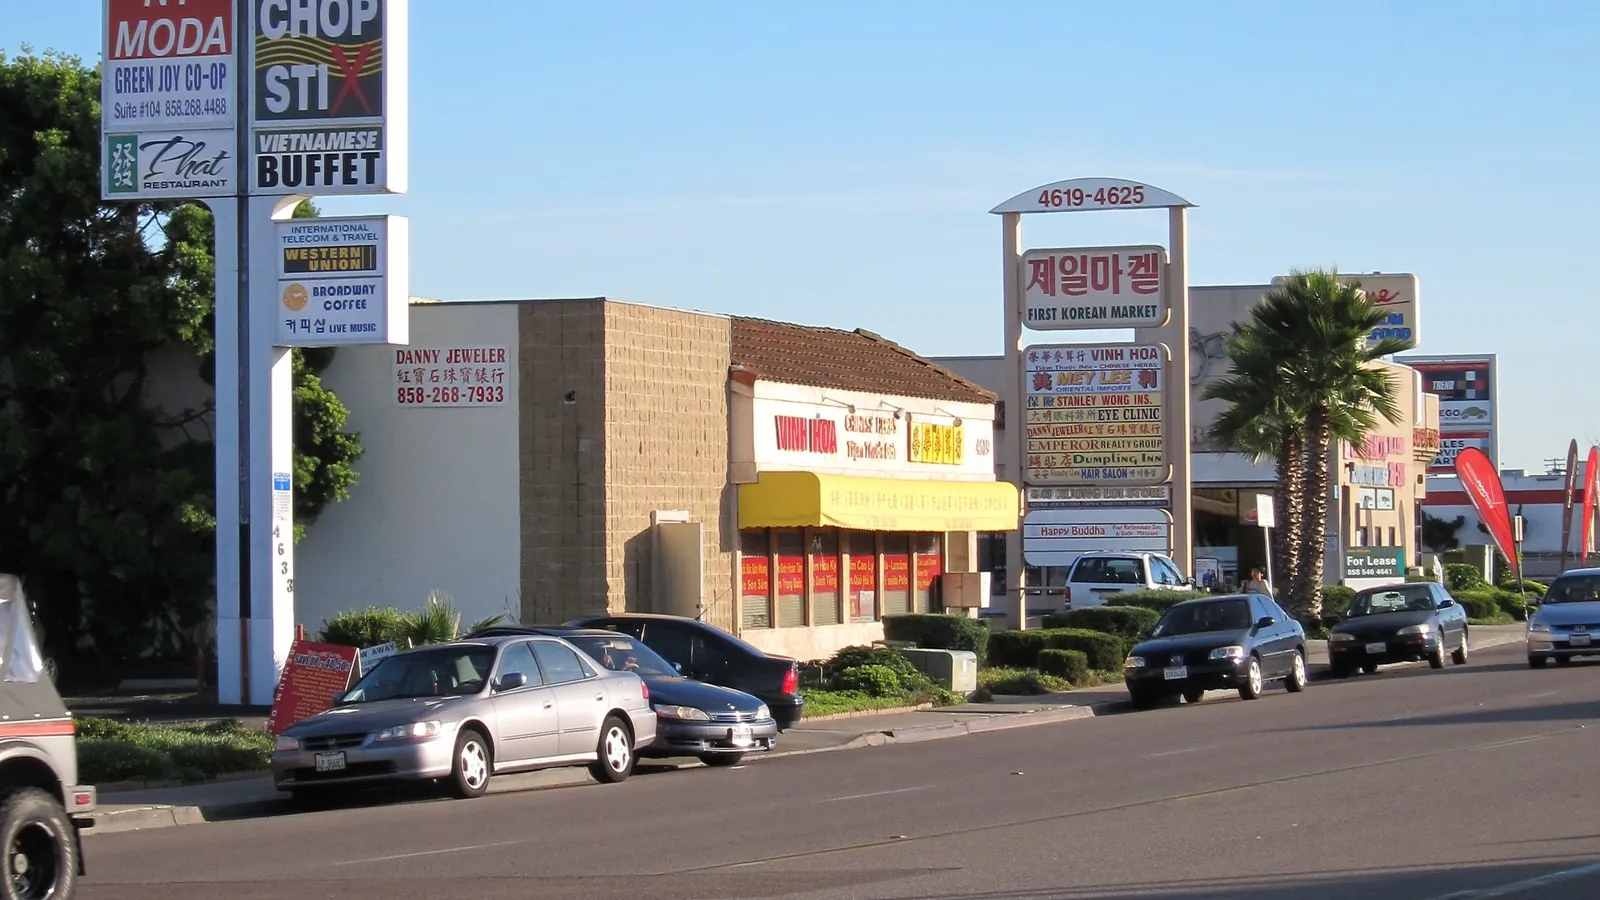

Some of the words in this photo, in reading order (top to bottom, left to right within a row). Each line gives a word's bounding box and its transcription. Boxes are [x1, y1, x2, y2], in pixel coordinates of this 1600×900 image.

[259, 0, 378, 40] CHOP
[115, 16, 227, 58] MODA
[115, 66, 154, 94] GREEN
[158, 64, 181, 92] JOY
[185, 62, 227, 91] CO-OP
[114, 101, 137, 119] Suite
[139, 100, 160, 118] #104
[165, 98, 227, 117] 858.268.4488
[258, 131, 378, 153] VIETNAMESE
[139, 136, 231, 180] Phat
[257, 152, 380, 188] BUFFET
[143, 180, 228, 190] RESTAURANT
[1038, 186, 1145, 207] 4619-4625
[291, 224, 369, 234] INTERNATIONAL
[282, 234, 329, 243] TELECOM
[332, 234, 340, 242] &
[342, 232, 379, 242] TRAVEL
[285, 246, 361, 260] WESTERN
[309, 258, 361, 271] UNION
[312, 284, 376, 297] BROADWAY
[323, 299, 367, 311] COFFEE
[1028, 308, 1057, 321] FIRST
[1061, 306, 1107, 320] KOREAN
[1110, 305, 1157, 319] MARKET
[329, 324, 347, 333] LIVE
[349, 323, 376, 333] MUSIC
[1367, 327, 1411, 340] FOOD
[396, 349, 440, 364] DANNY
[446, 348, 505, 364] JEWELER
[1090, 348, 1124, 361] VINH
[1129, 347, 1158, 360] HOA
[1055, 371, 1096, 386] MEY
[1099, 370, 1132, 385] LEE
[397, 386, 504, 403] 858-268-7933
[1056, 395, 1097, 407] STANLEY
[1101, 394, 1130, 406] WONG
[1134, 394, 1152, 405] INS.
[1098, 409, 1120, 421] EYE
[1123, 407, 1160, 420] CLINIC
[1438, 408, 1461, 418] EGO
[774, 414, 807, 452] VINH
[808, 418, 838, 454] HOA
[1027, 425, 1051, 438] DANNY
[1051, 425, 1083, 436] JEWELER
[1028, 440, 1100, 451] EMPEROR
[1100, 440, 1132, 449] REALTY
[1133, 440, 1162, 449] GROUP
[1439, 440, 1465, 448] LES
[1081, 468, 1100, 480] HAIR
[1102, 468, 1128, 479] SALON
[1041, 527, 1069, 536] Happy
[1071, 525, 1105, 536] Buddha
[1346, 556, 1365, 566] For
[1367, 556, 1397, 566] Lease
[371, 643, 395, 656] AWAY
